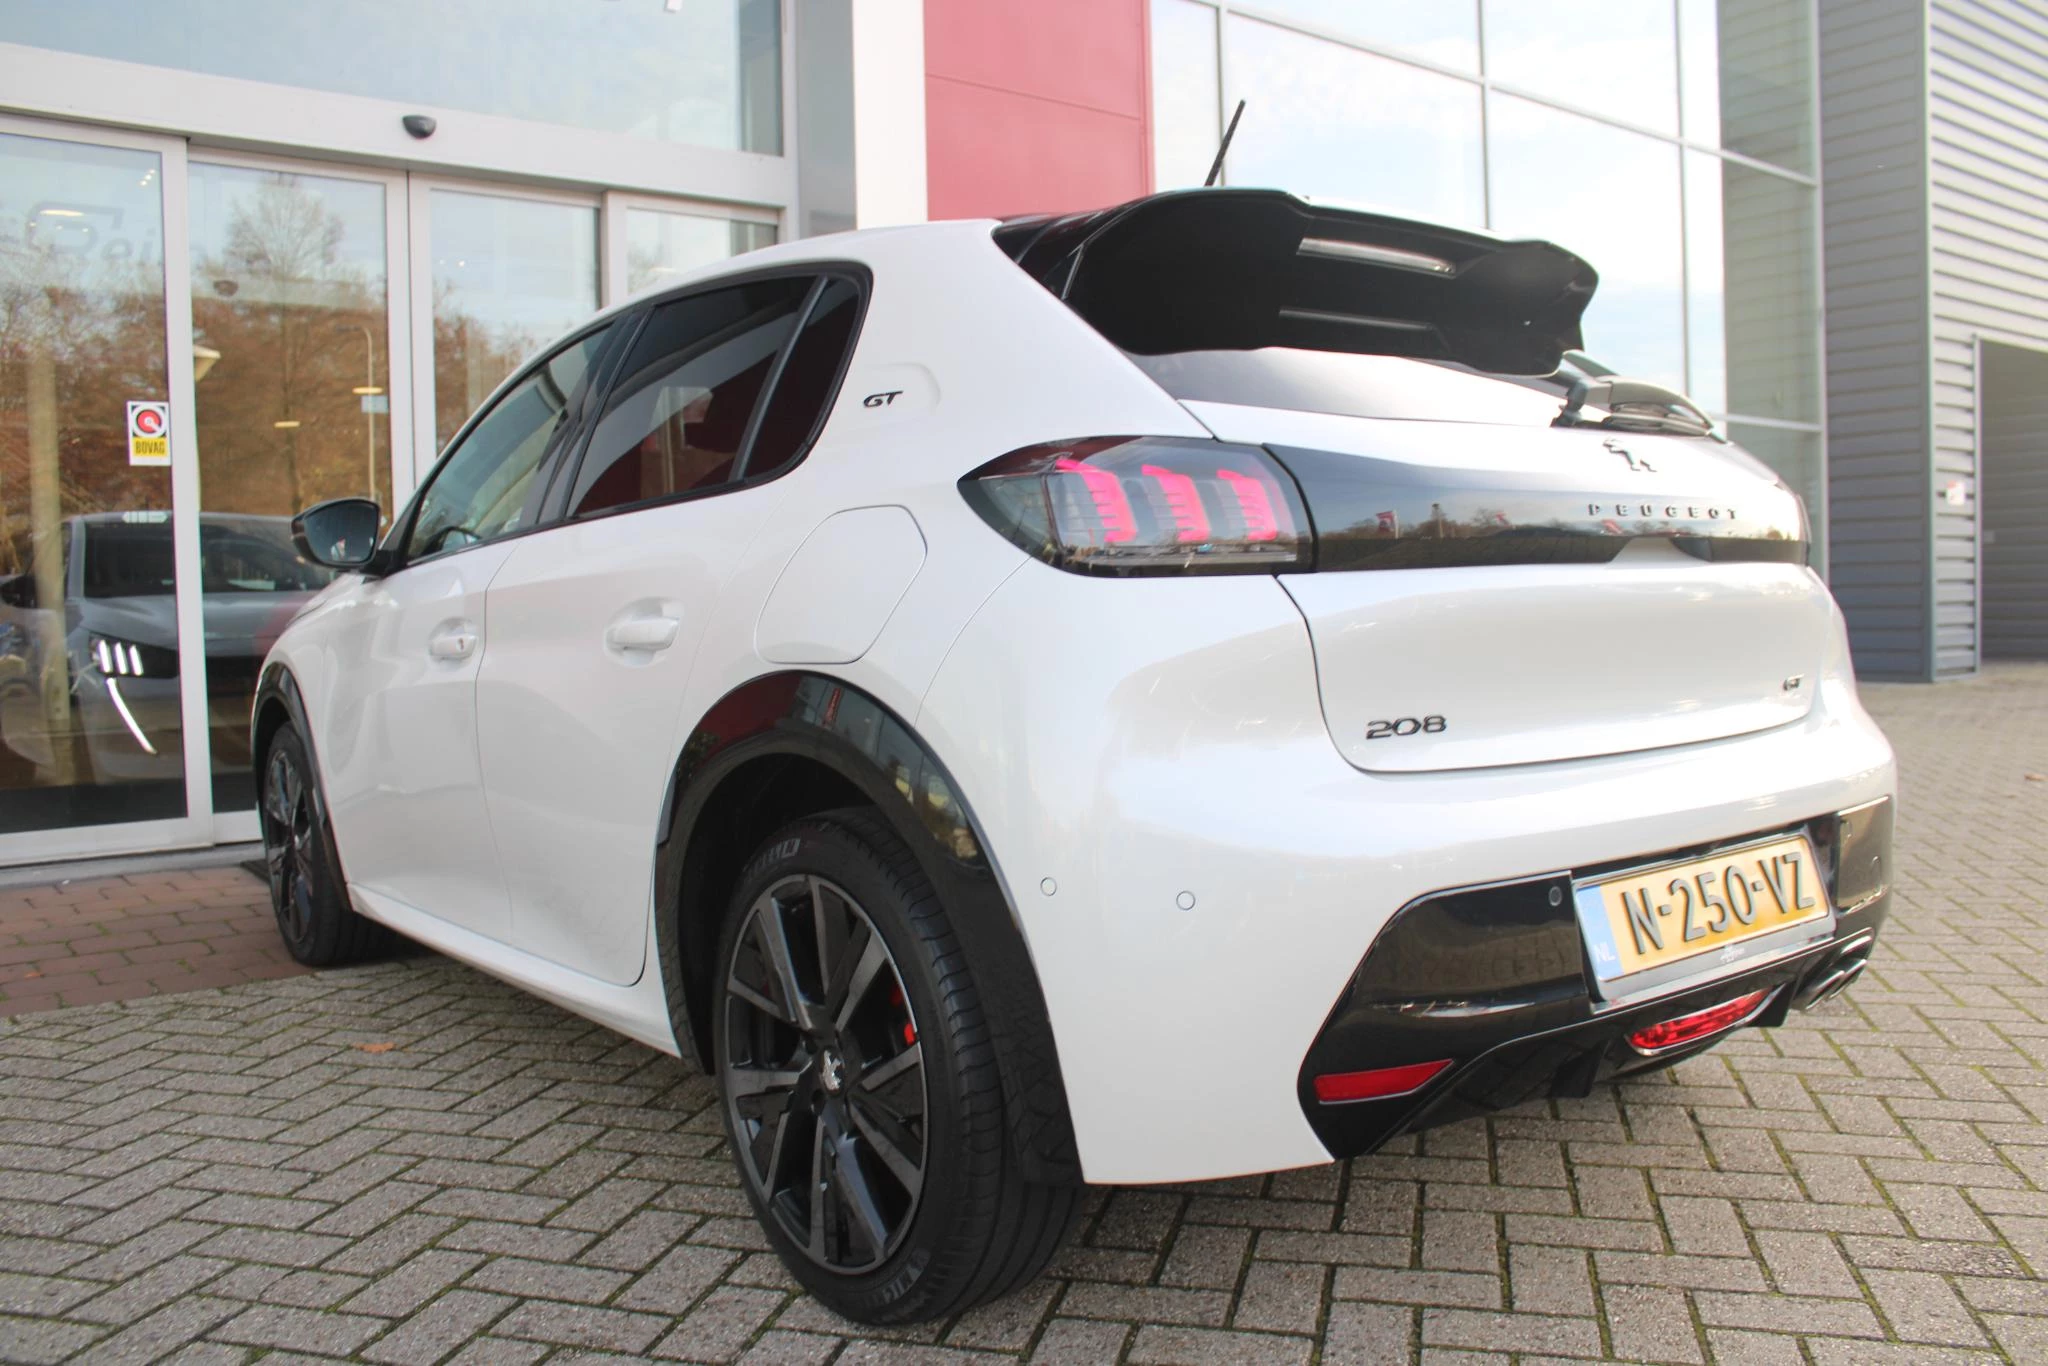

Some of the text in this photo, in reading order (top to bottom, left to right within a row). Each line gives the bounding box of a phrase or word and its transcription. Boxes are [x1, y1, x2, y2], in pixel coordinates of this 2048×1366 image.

[863, 390, 904, 408] GT
[134, 440, 166, 455] BOVAG
[1587, 503, 1737, 520] PEUGEOT
[1366, 714, 1448, 740] 208
[1621, 851, 1815, 955] N-250-VZ
[1593, 942, 1617, 963] NL
